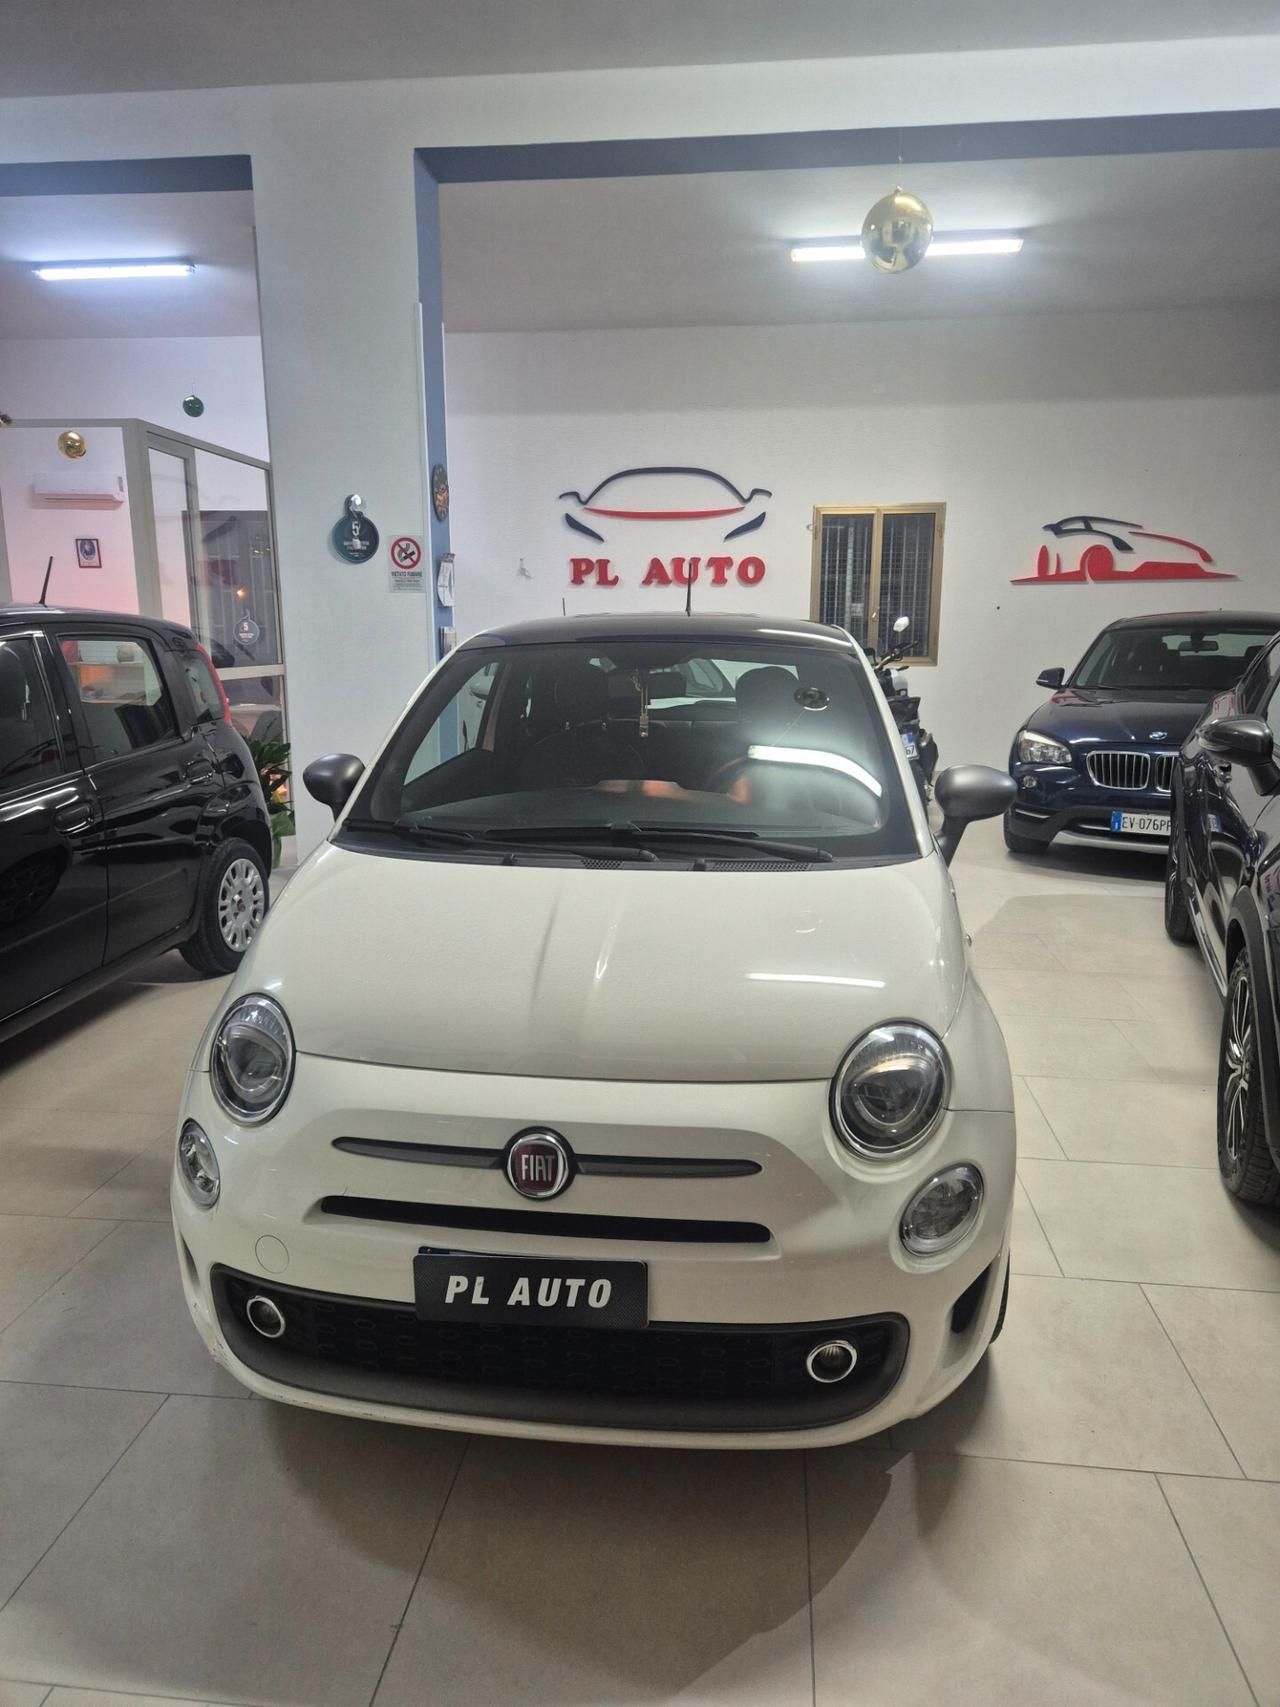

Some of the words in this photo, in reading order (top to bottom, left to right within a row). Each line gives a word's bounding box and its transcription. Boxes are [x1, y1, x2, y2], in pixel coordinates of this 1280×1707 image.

[570, 557, 619, 586] PL
[641, 556, 766, 586] AUTO
[1122, 816, 1136, 829] EV
[521, 1154, 555, 1182] FIAT
[444, 1275, 490, 1305] PL
[506, 1277, 612, 1309] AUTO
